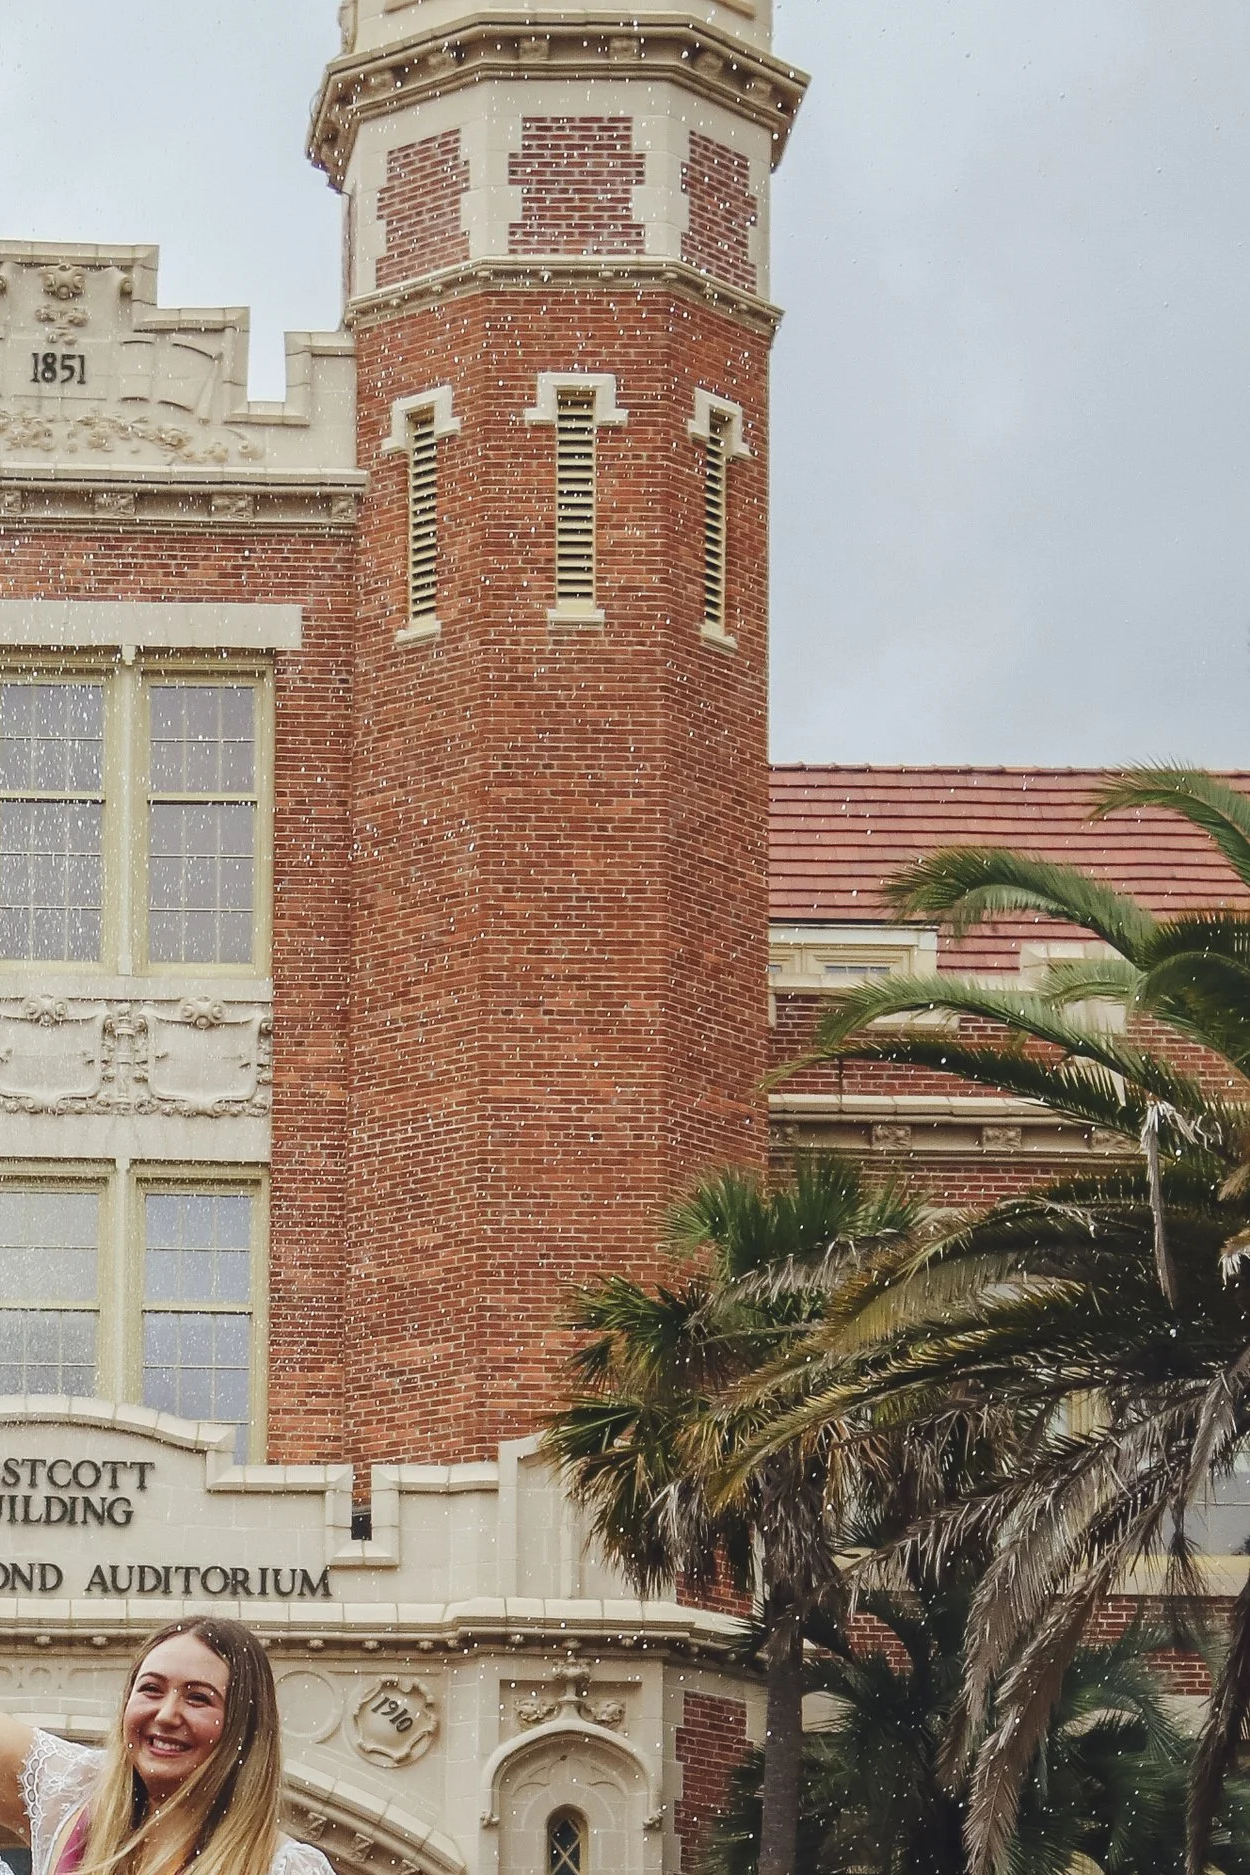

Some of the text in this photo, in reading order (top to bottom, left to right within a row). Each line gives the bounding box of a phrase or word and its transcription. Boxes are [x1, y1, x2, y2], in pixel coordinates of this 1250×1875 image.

[30, 352, 86, 385] 1851
[84, 1564, 333, 1597] AUDITORIUM
[371, 1697, 413, 1733] 1910
